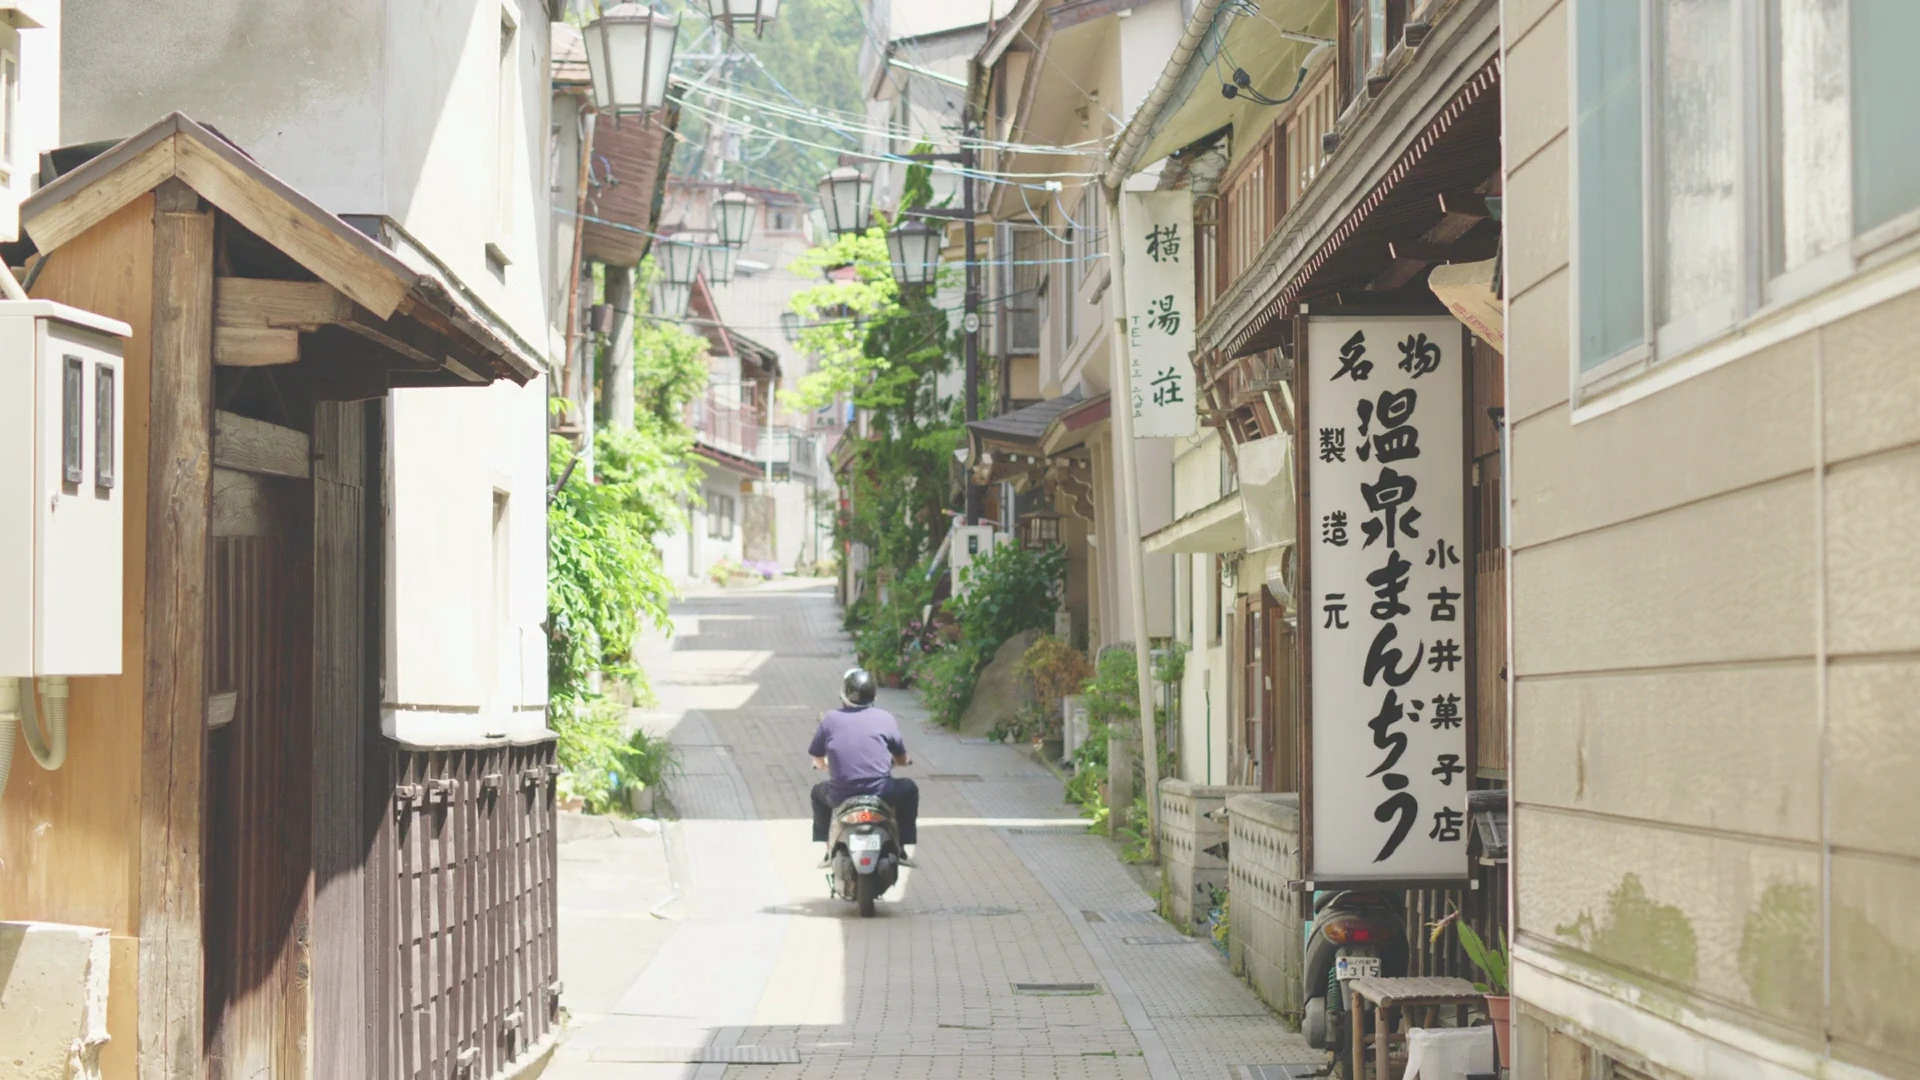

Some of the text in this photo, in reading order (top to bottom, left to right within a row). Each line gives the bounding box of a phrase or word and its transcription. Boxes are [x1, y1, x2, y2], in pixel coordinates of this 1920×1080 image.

[1131, 315, 1142, 348] TEL
[1330, 329, 1441, 382] 名物
[1319, 427, 1350, 630] 製造元
[1355, 388, 1425, 864] 温泉まんぢう
[1425, 538, 1466, 842] 小古井菓子店
[1350, 965, 1380, 978] 315
